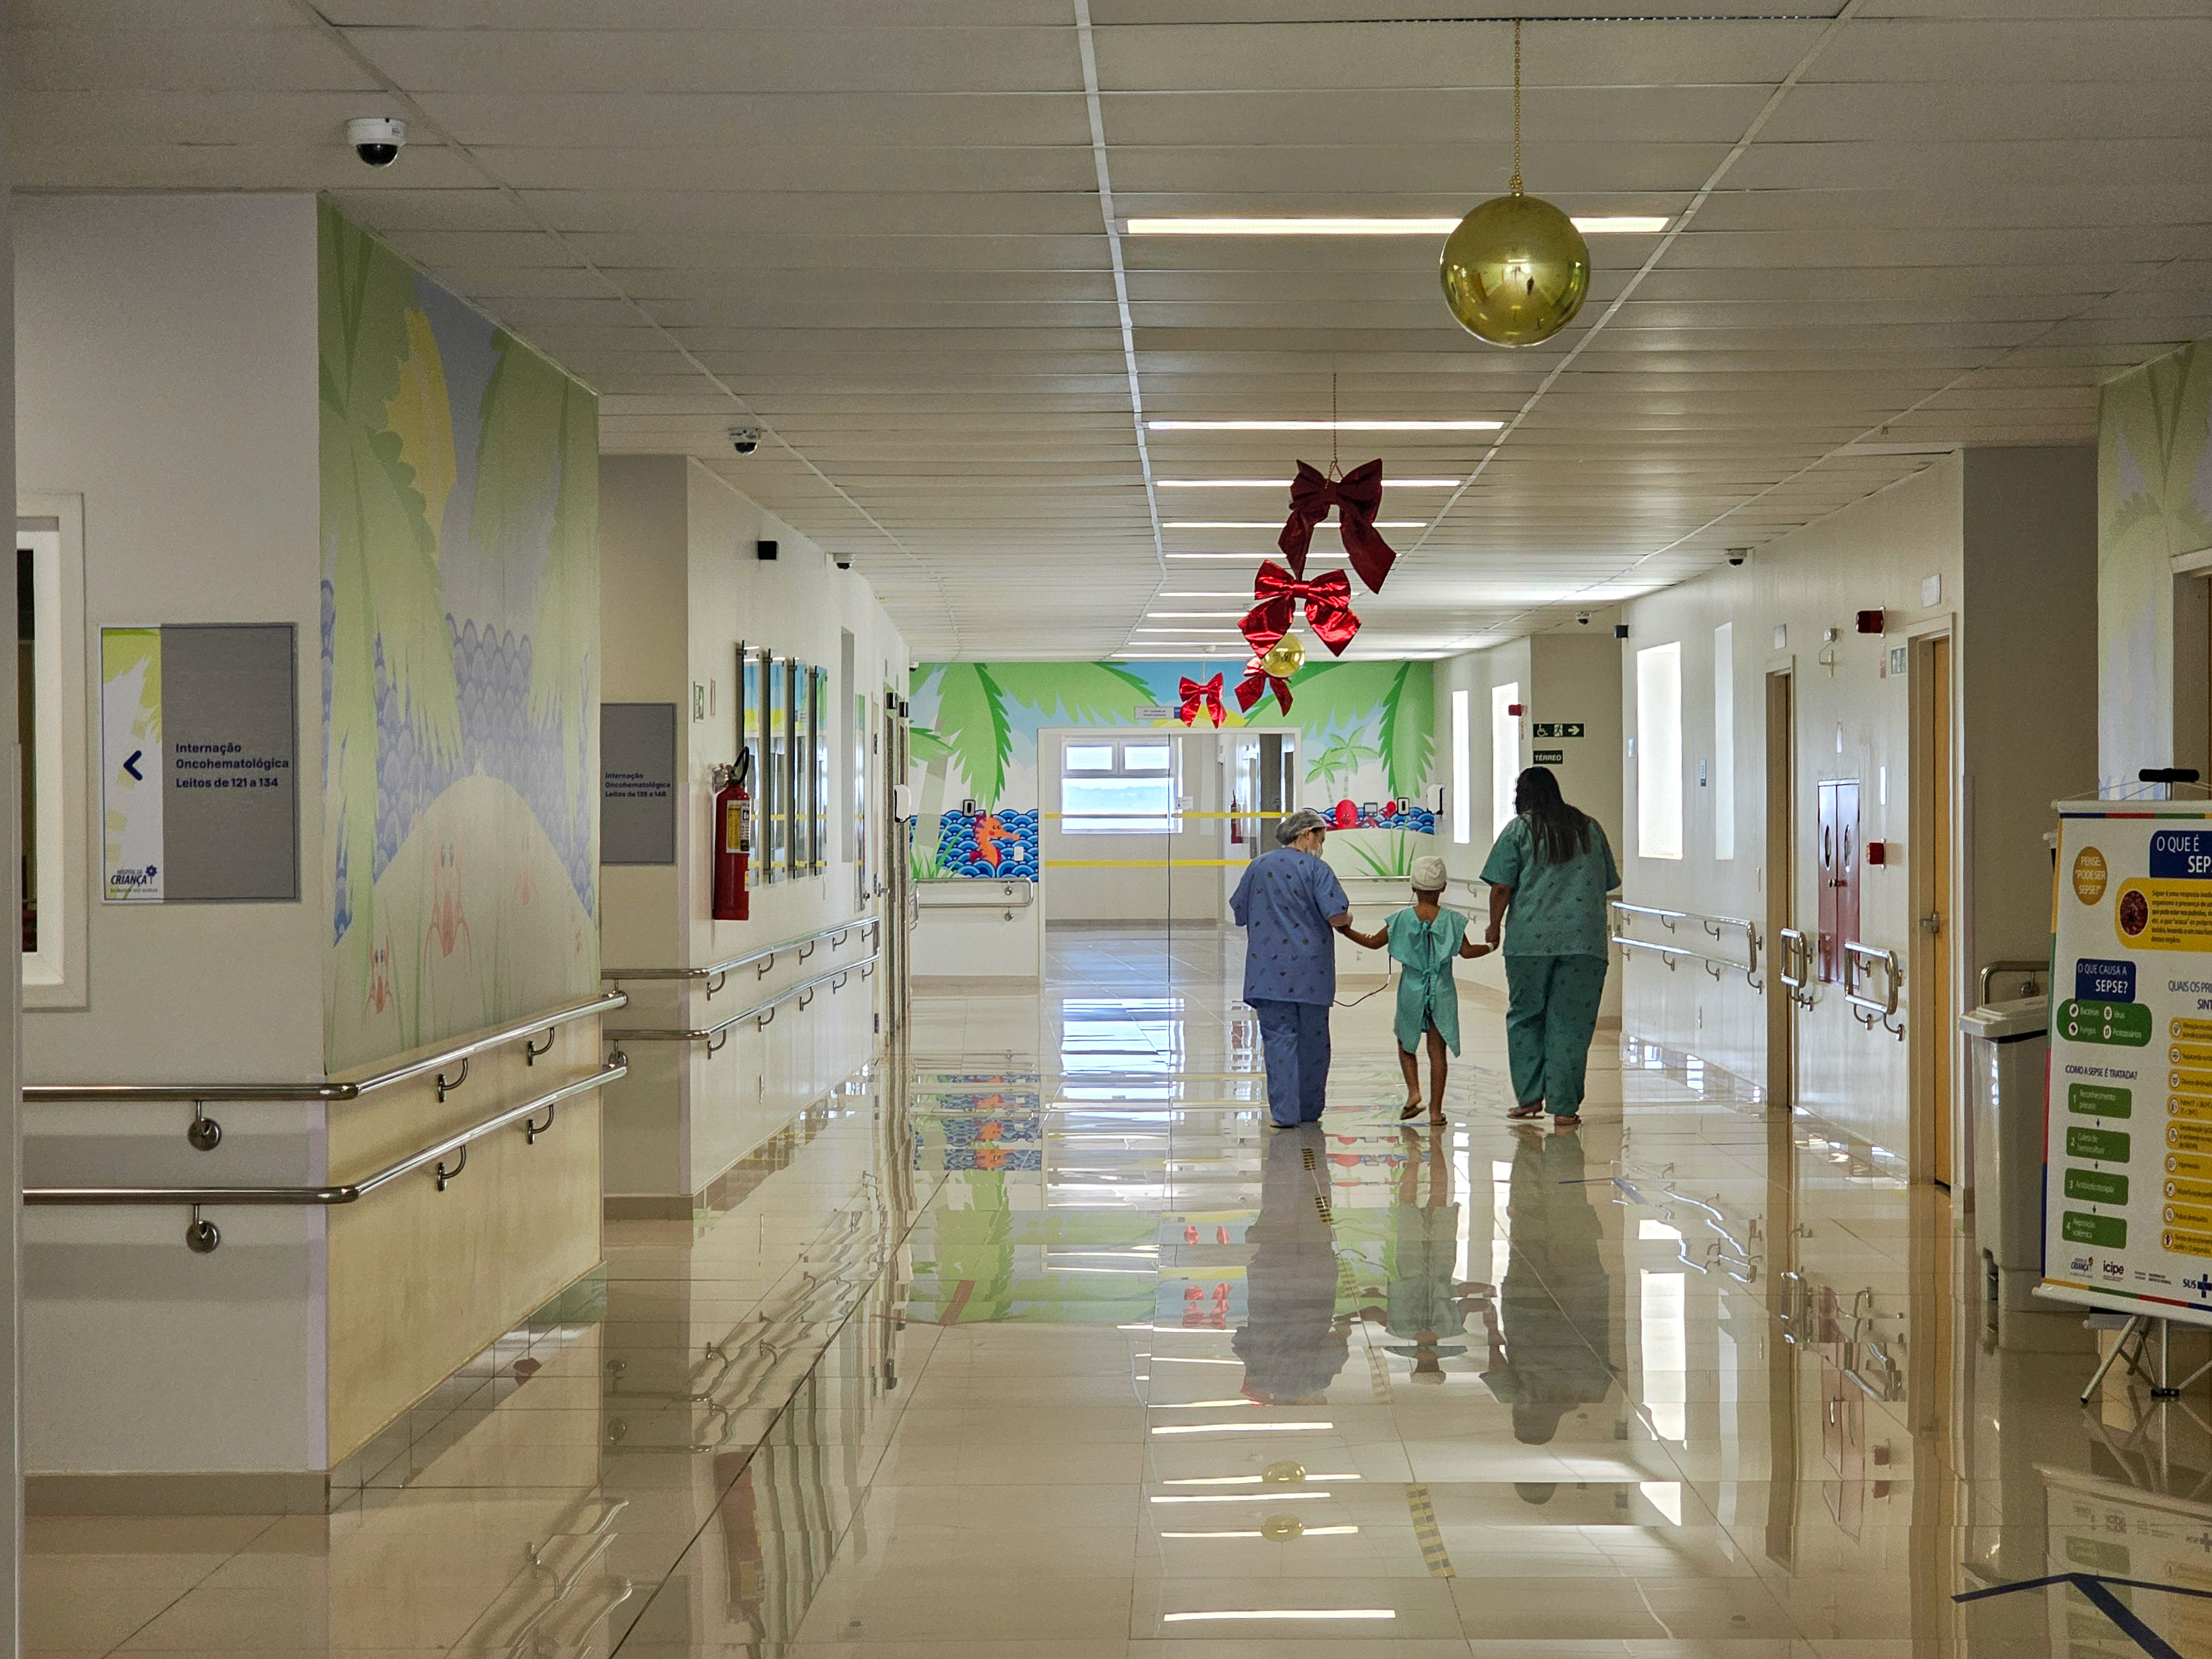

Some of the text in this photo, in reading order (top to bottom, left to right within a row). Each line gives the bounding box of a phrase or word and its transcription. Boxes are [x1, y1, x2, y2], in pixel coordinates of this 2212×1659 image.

[176, 743, 241, 755] Internação
[176, 757, 289, 771] Oncohematológica
[176, 777, 212, 788] Leitos
[214, 777, 229, 788] de
[232, 777, 247, 788] 121
[260, 777, 278, 788] 134
[2156, 833, 2199, 853] O QUE É
[2188, 855, 2212, 873] SEP
[111, 874, 147, 887] CRIANÇA
[2078, 964, 2127, 976] O QUE CAUSA A
[2095, 979, 2128, 994] SEPSE?
[2168, 980, 2189, 993] QUAIS
[2189, 981, 2200, 992] OS
[2065, 1064, 2083, 1074] COMO
[2089, 1066, 2103, 1077] SEPSE
[2104, 1066, 2108, 1078] É
[2109, 1069, 2138, 1080] TRATADA?
[2070, 1137, 2075, 1146] 2
[2069, 1180, 2073, 1190] 3
[2103, 1259, 2125, 1276] icipe
[2183, 1278, 2197, 1289] SUS
